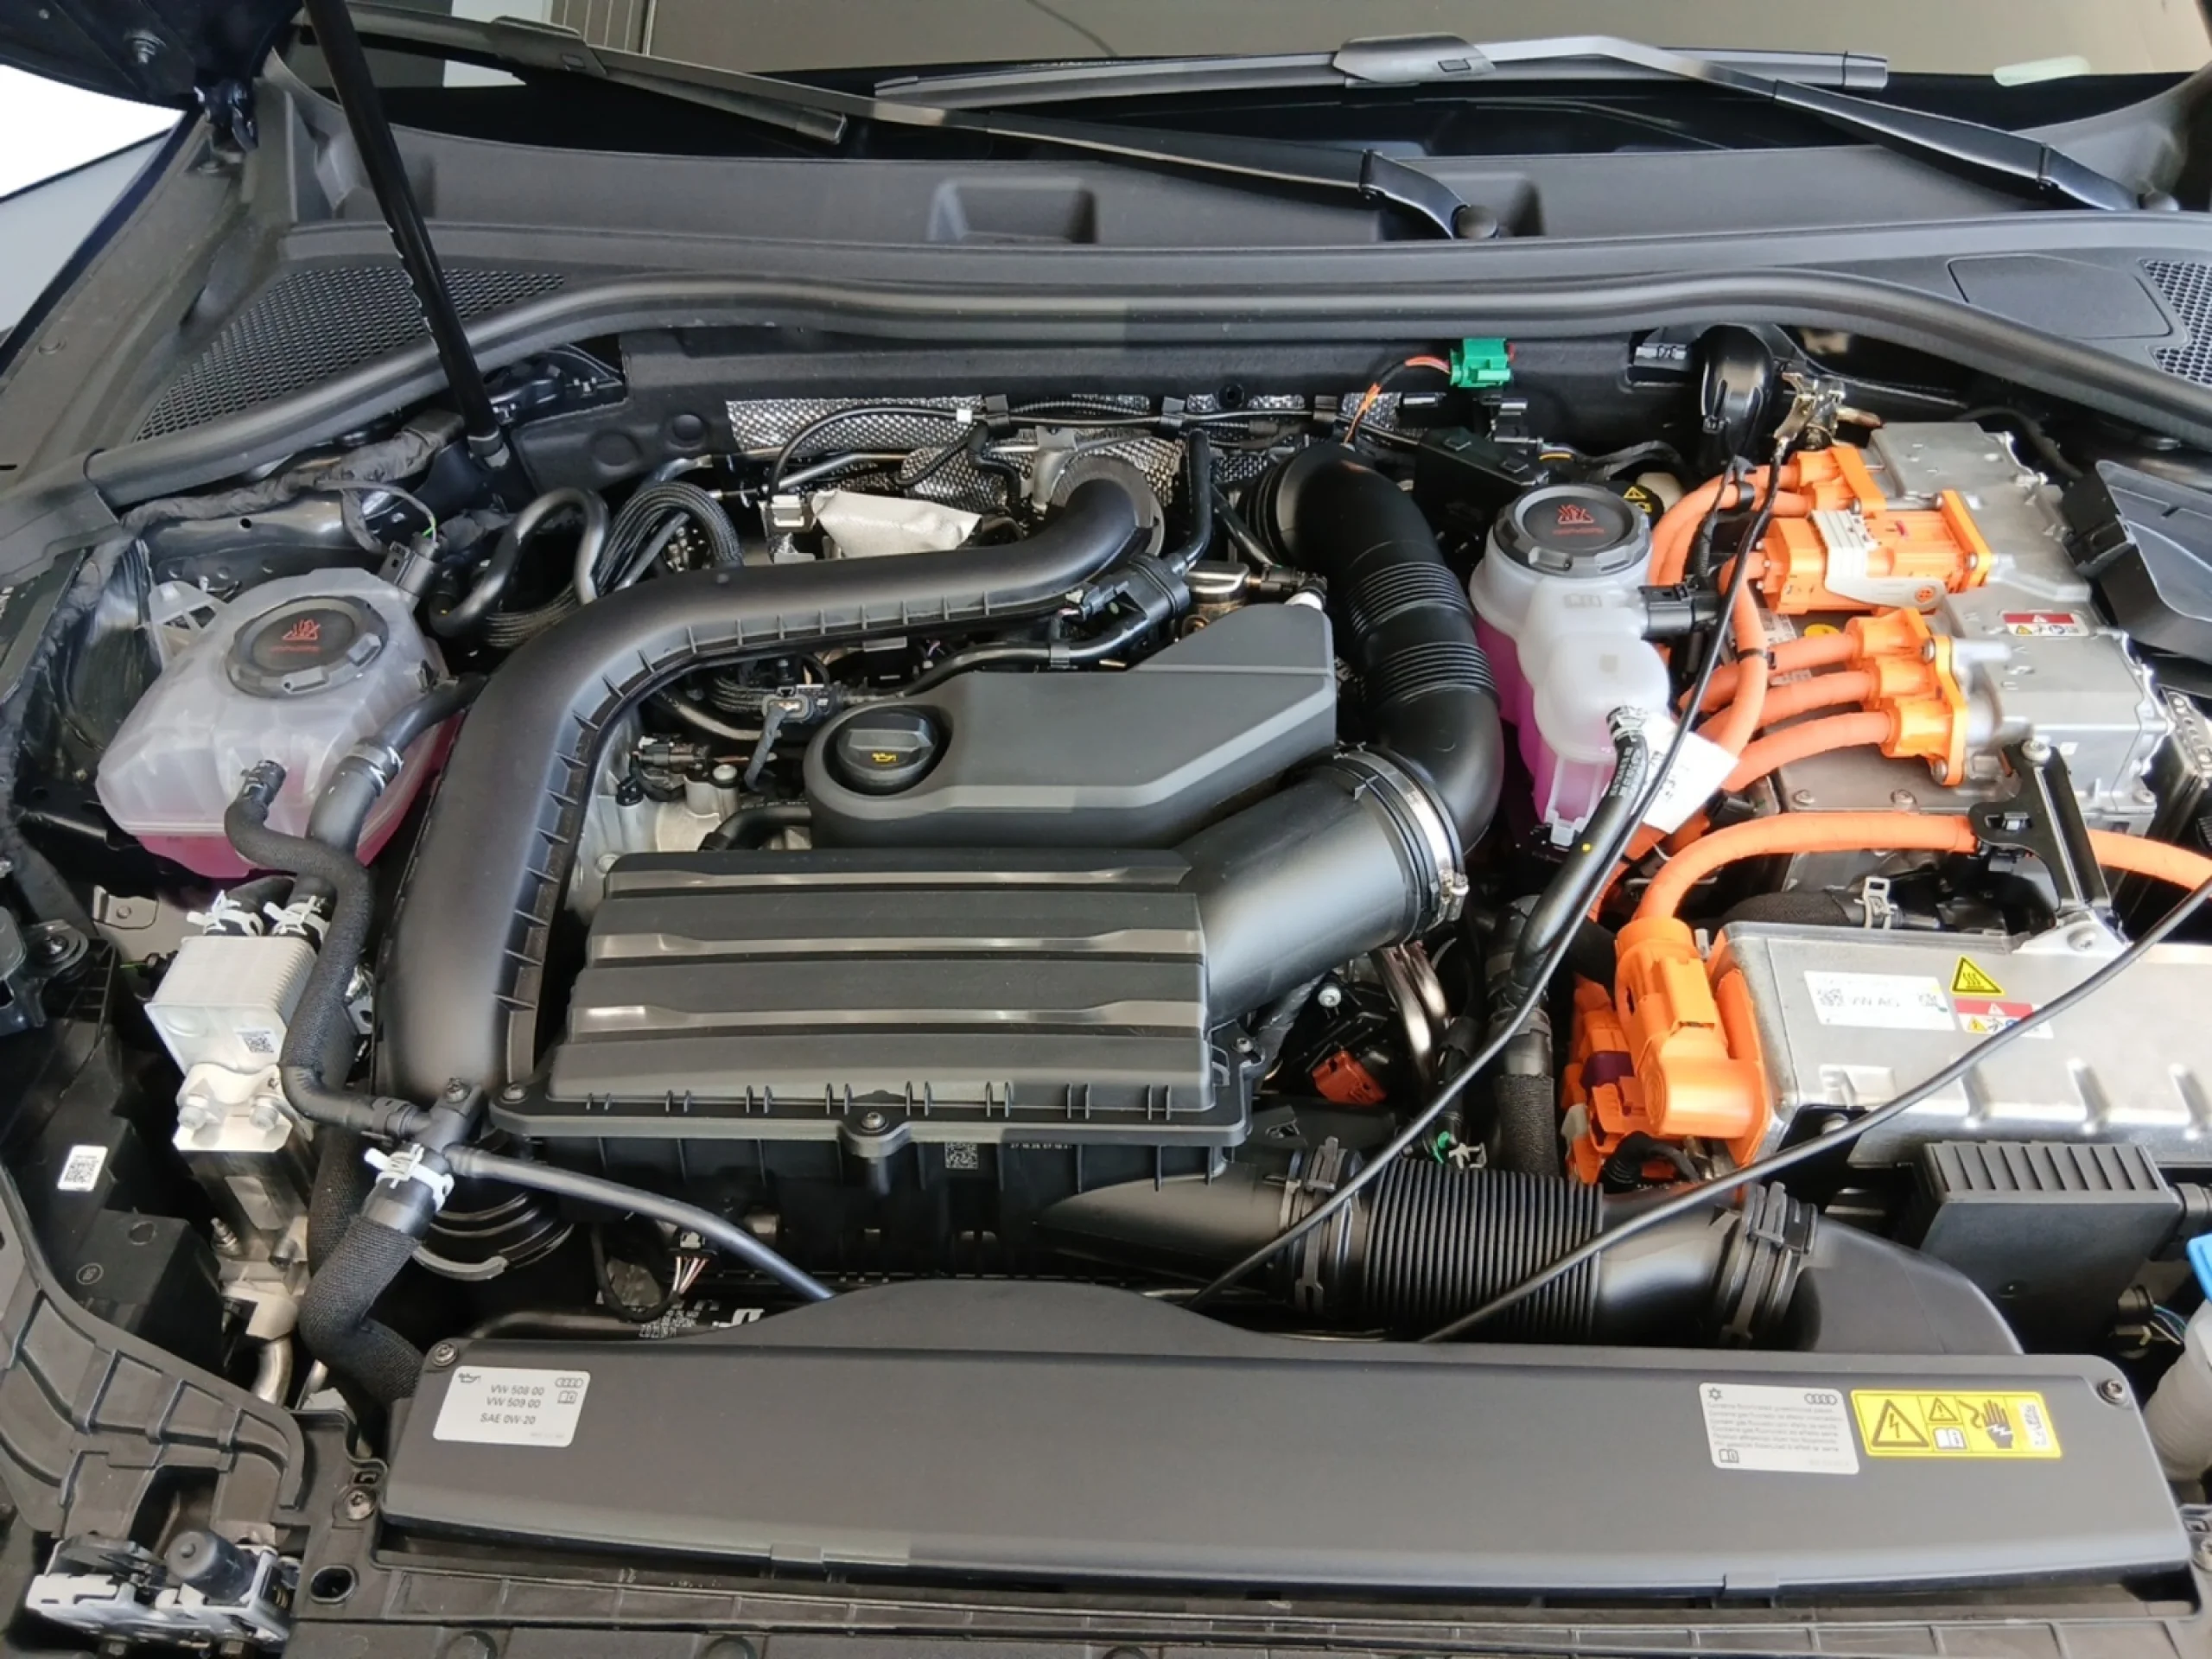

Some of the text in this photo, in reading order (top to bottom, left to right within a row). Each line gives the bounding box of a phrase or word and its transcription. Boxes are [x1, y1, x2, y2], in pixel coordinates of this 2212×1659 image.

[491, 1384, 544, 1395] VW 508 00
[486, 1396, 541, 1408] VW 509 00
[480, 1413, 537, 1425] SAE 0W-20
